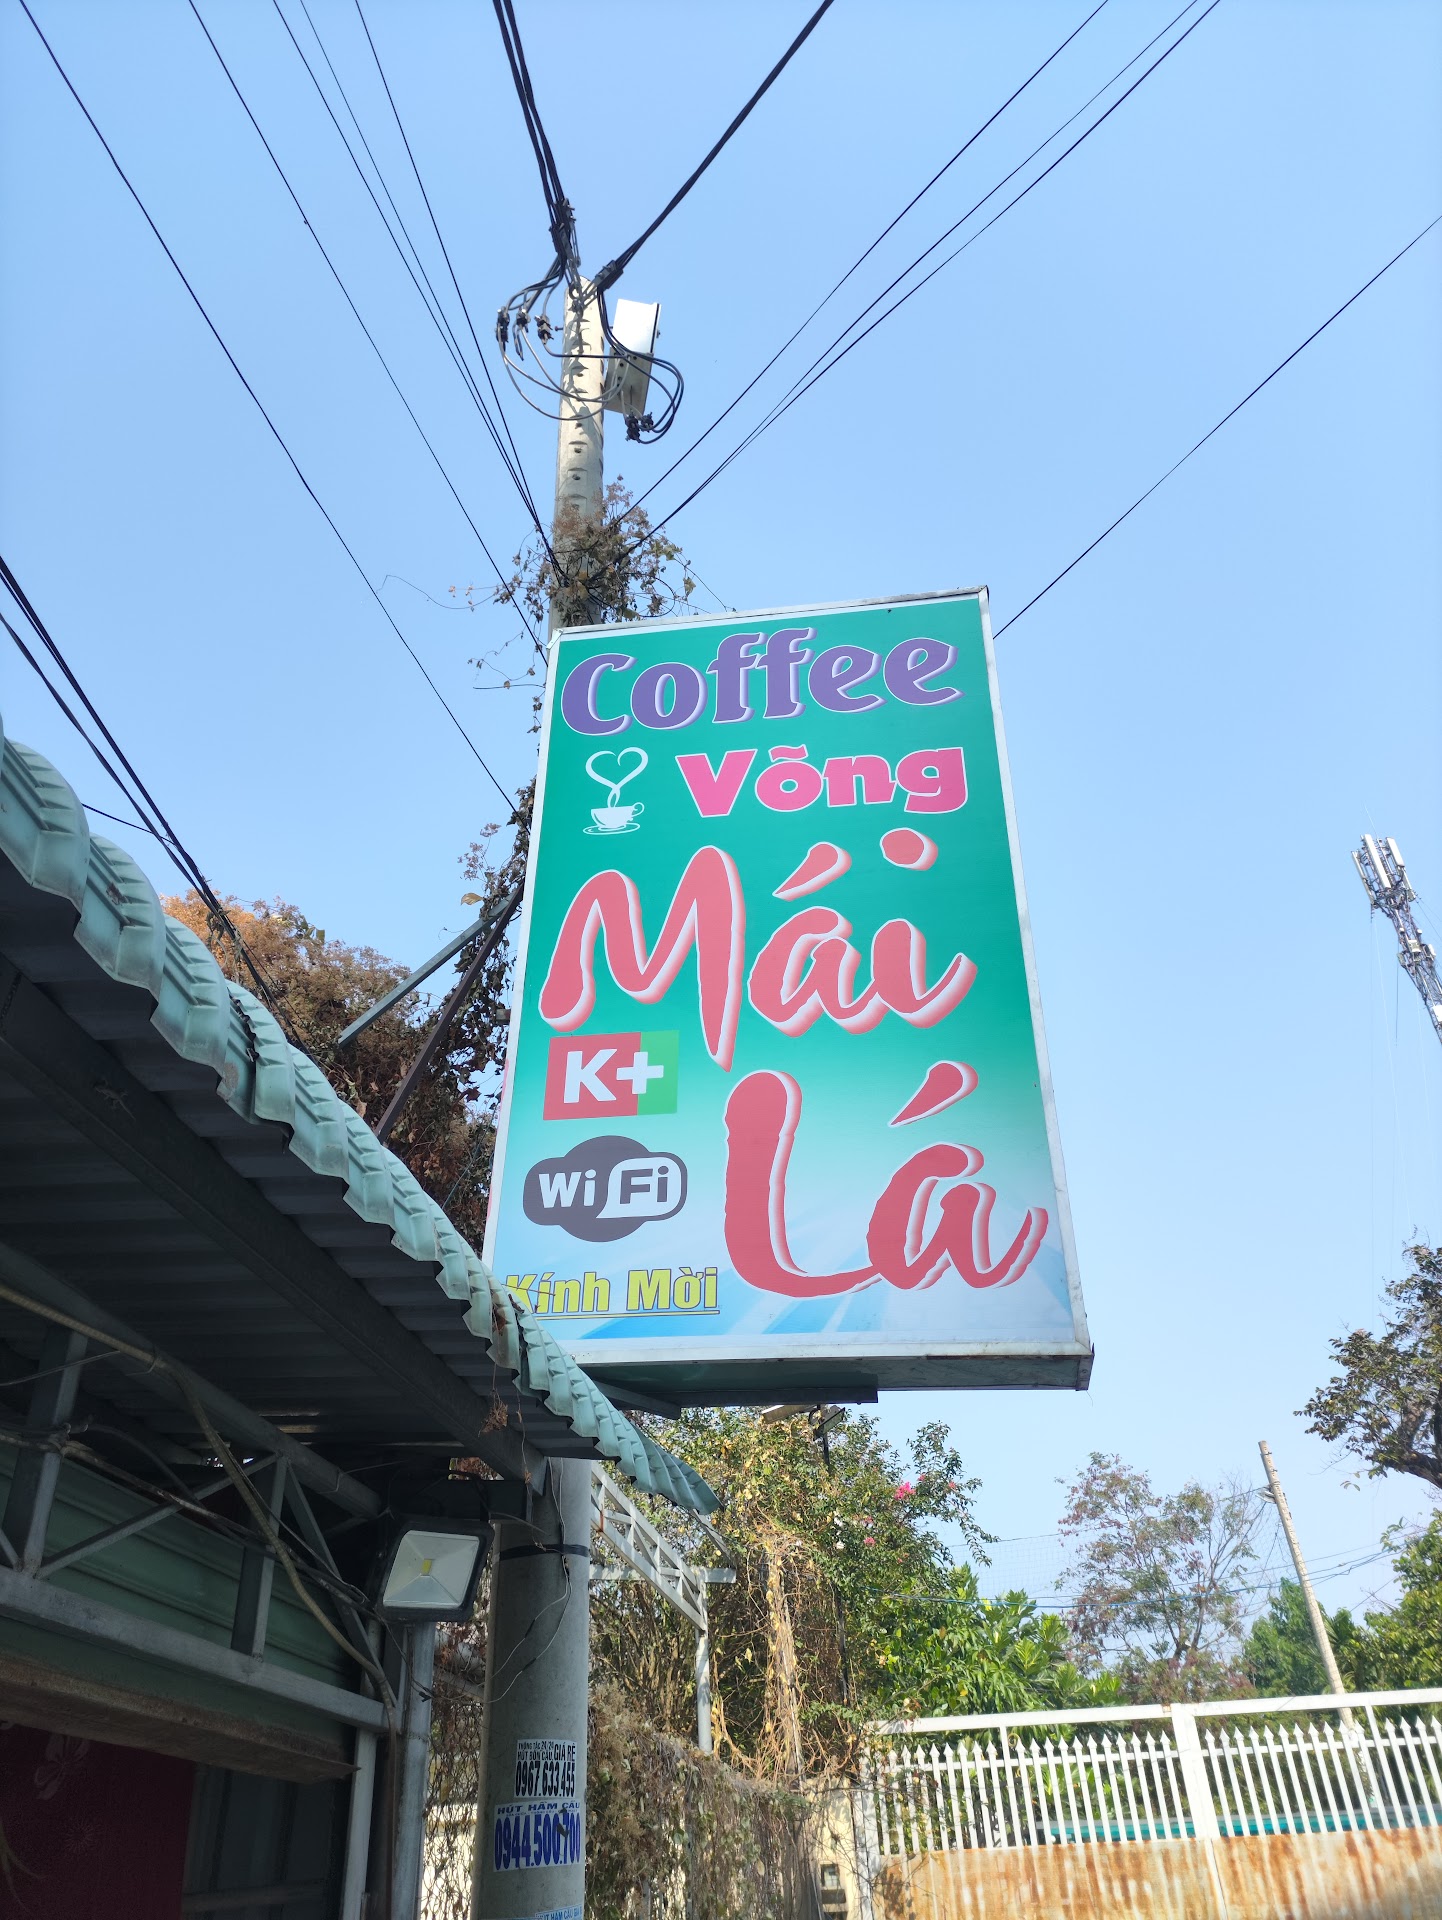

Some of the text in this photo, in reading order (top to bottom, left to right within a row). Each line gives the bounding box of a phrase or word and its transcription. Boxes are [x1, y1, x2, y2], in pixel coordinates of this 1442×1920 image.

[561, 627, 965, 736] Coffee
[675, 744, 968, 818] Võng
[538, 827, 978, 1072] Mái
[563, 1047, 664, 1104] K+
[724, 1060, 1049, 1299] Lá
[506, 1267, 718, 1315] Kính Mời
[515, 1760, 575, 1797] 0967.633.455
[554, 1741, 566, 1761] GIÁ
[497, 1804, 523, 1815] HÚT
[528, 1800, 558, 1812] HẦM
[494, 1812, 581, 1871] 0944.500.700
